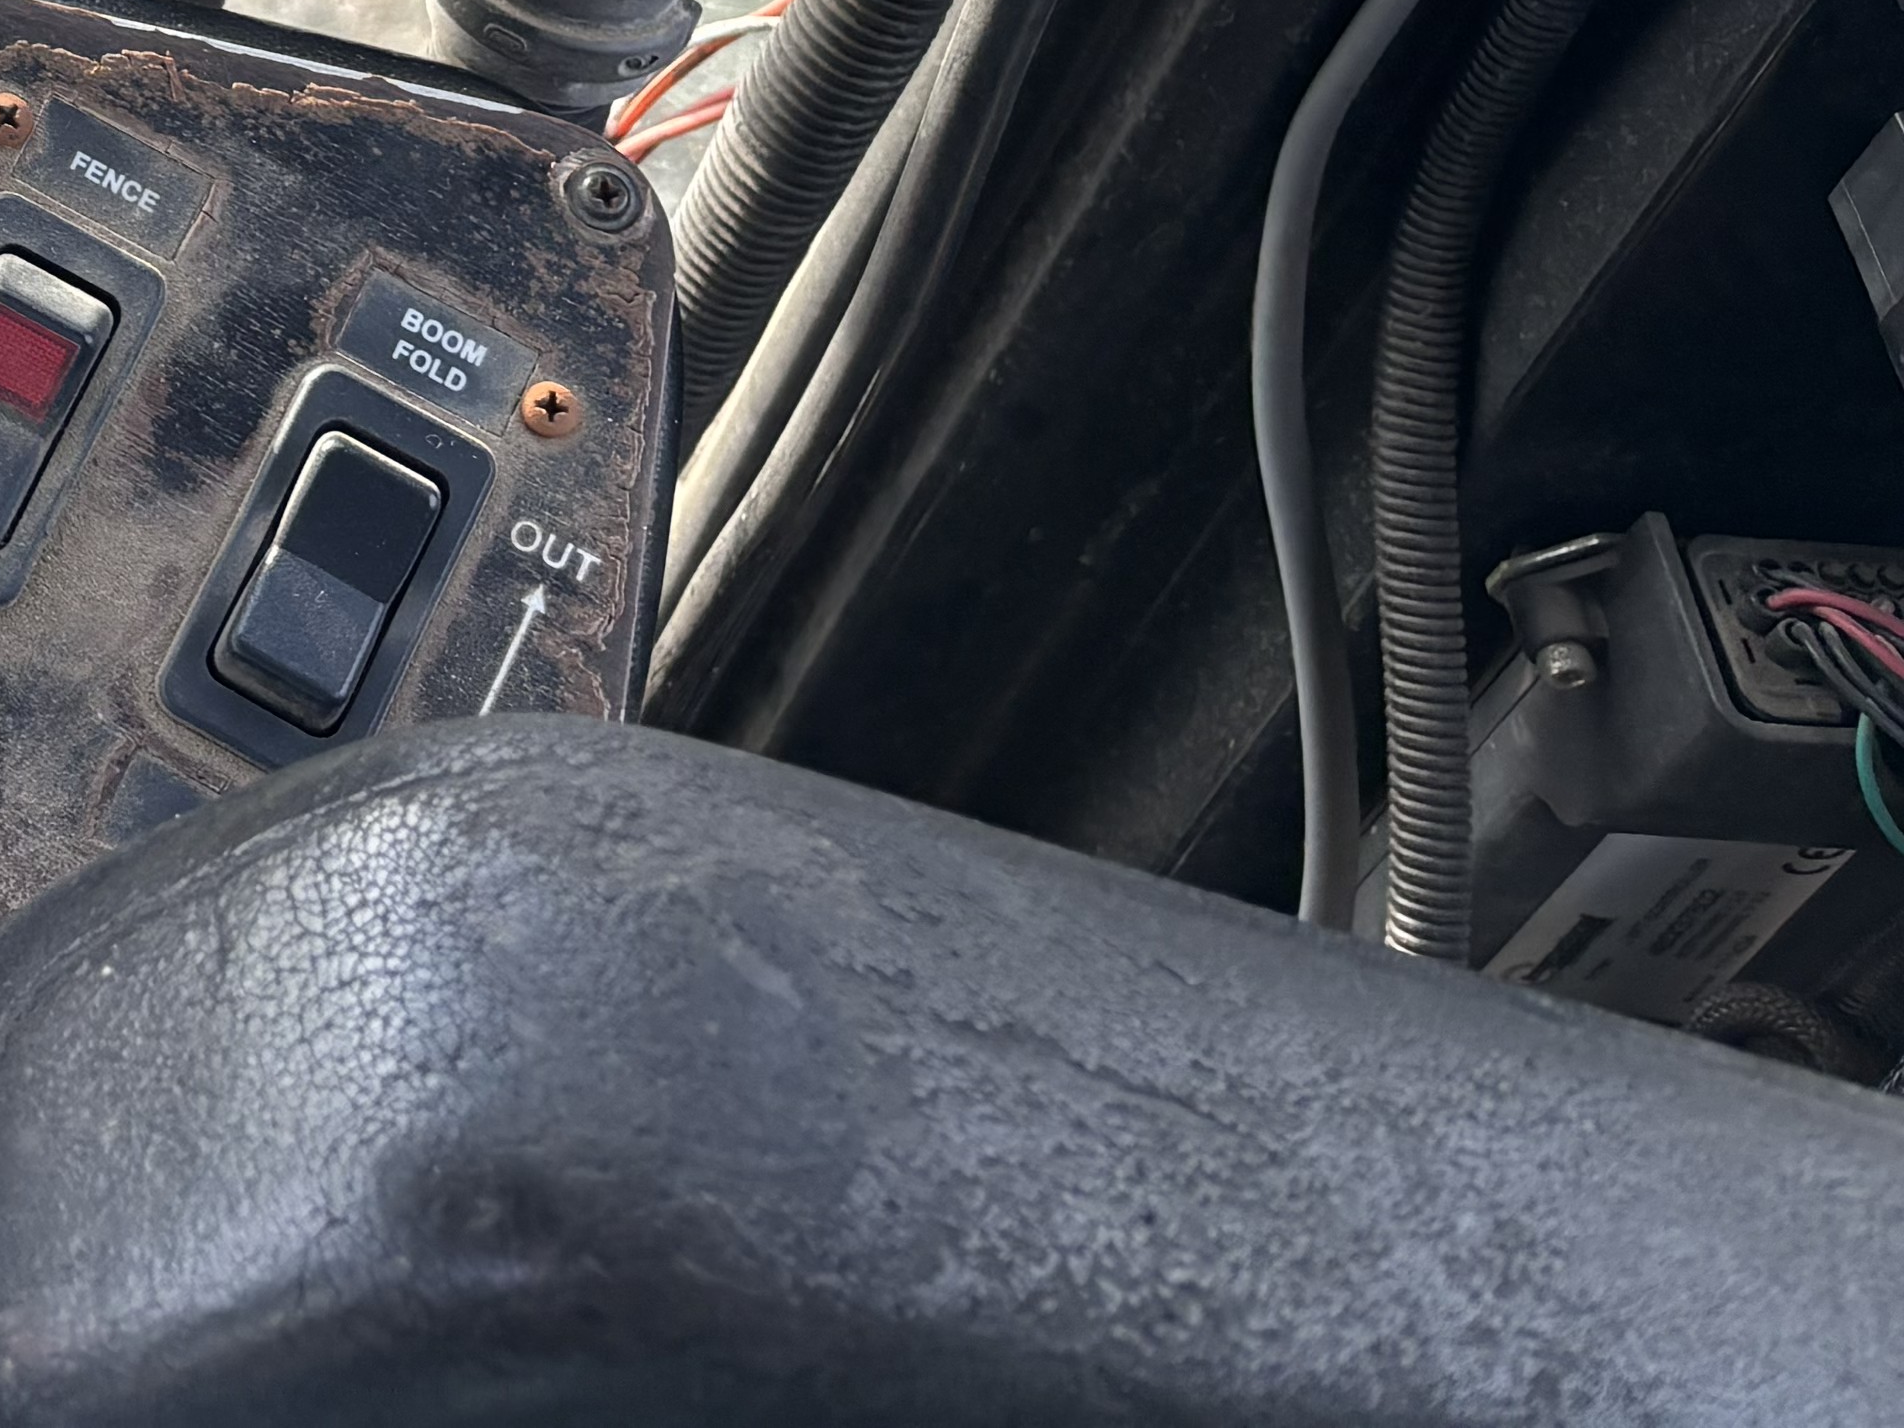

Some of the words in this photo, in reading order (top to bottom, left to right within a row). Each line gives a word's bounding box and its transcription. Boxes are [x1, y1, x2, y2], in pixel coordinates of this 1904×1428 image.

[69, 150, 161, 212] FENCE
[392, 339, 468, 394] FOLD
[401, 305, 486, 367] BOOM
[508, 519, 601, 585] OUT
